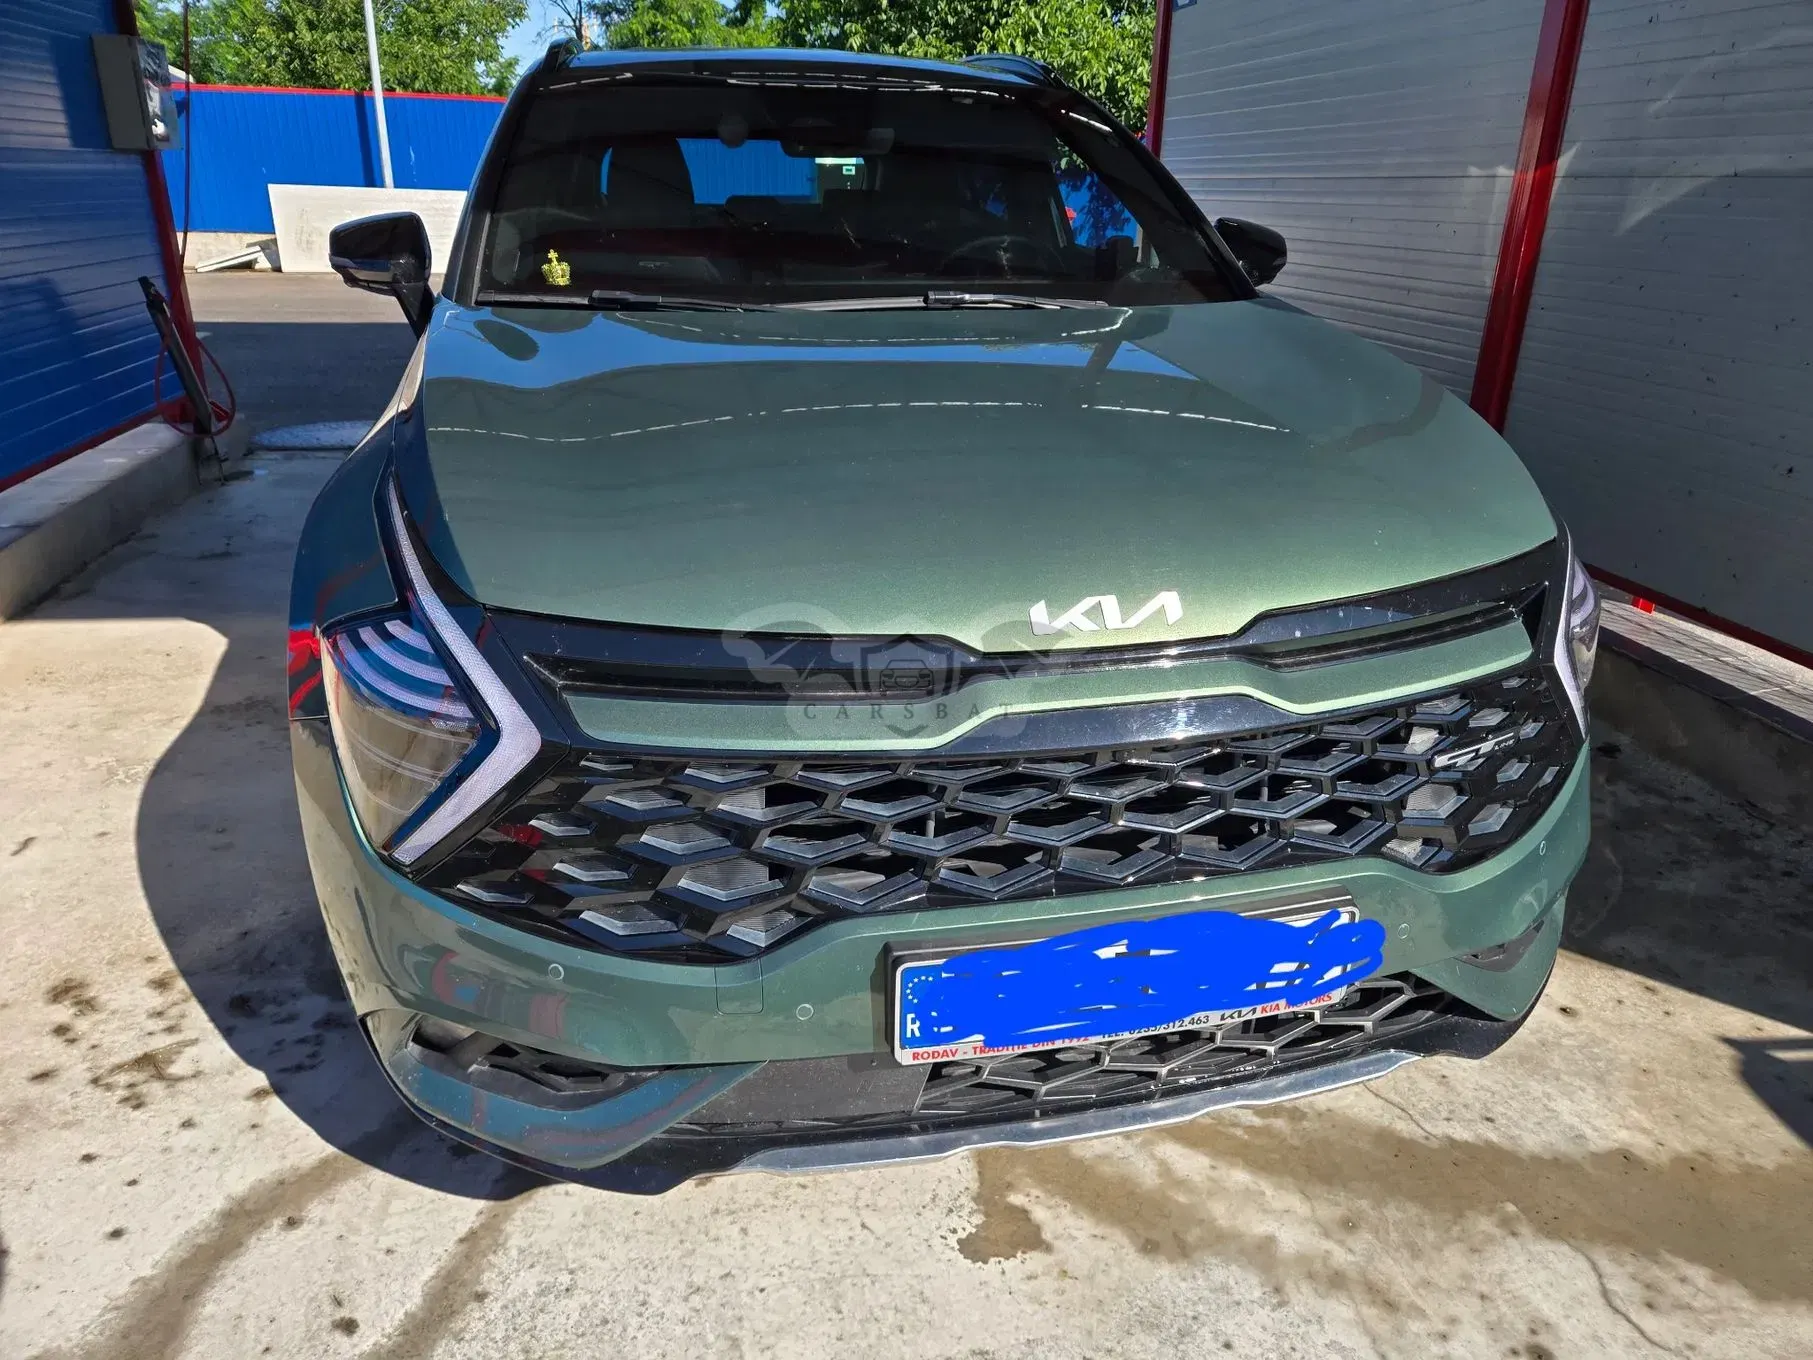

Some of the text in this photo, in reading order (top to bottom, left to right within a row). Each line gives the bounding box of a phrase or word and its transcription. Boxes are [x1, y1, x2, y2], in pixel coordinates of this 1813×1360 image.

[1028, 590, 1184, 637] KIA
[912, 1048, 959, 1061] RODAV
[1260, 1003, 1280, 1015] KIA
[1284, 993, 1332, 1010] MORS
